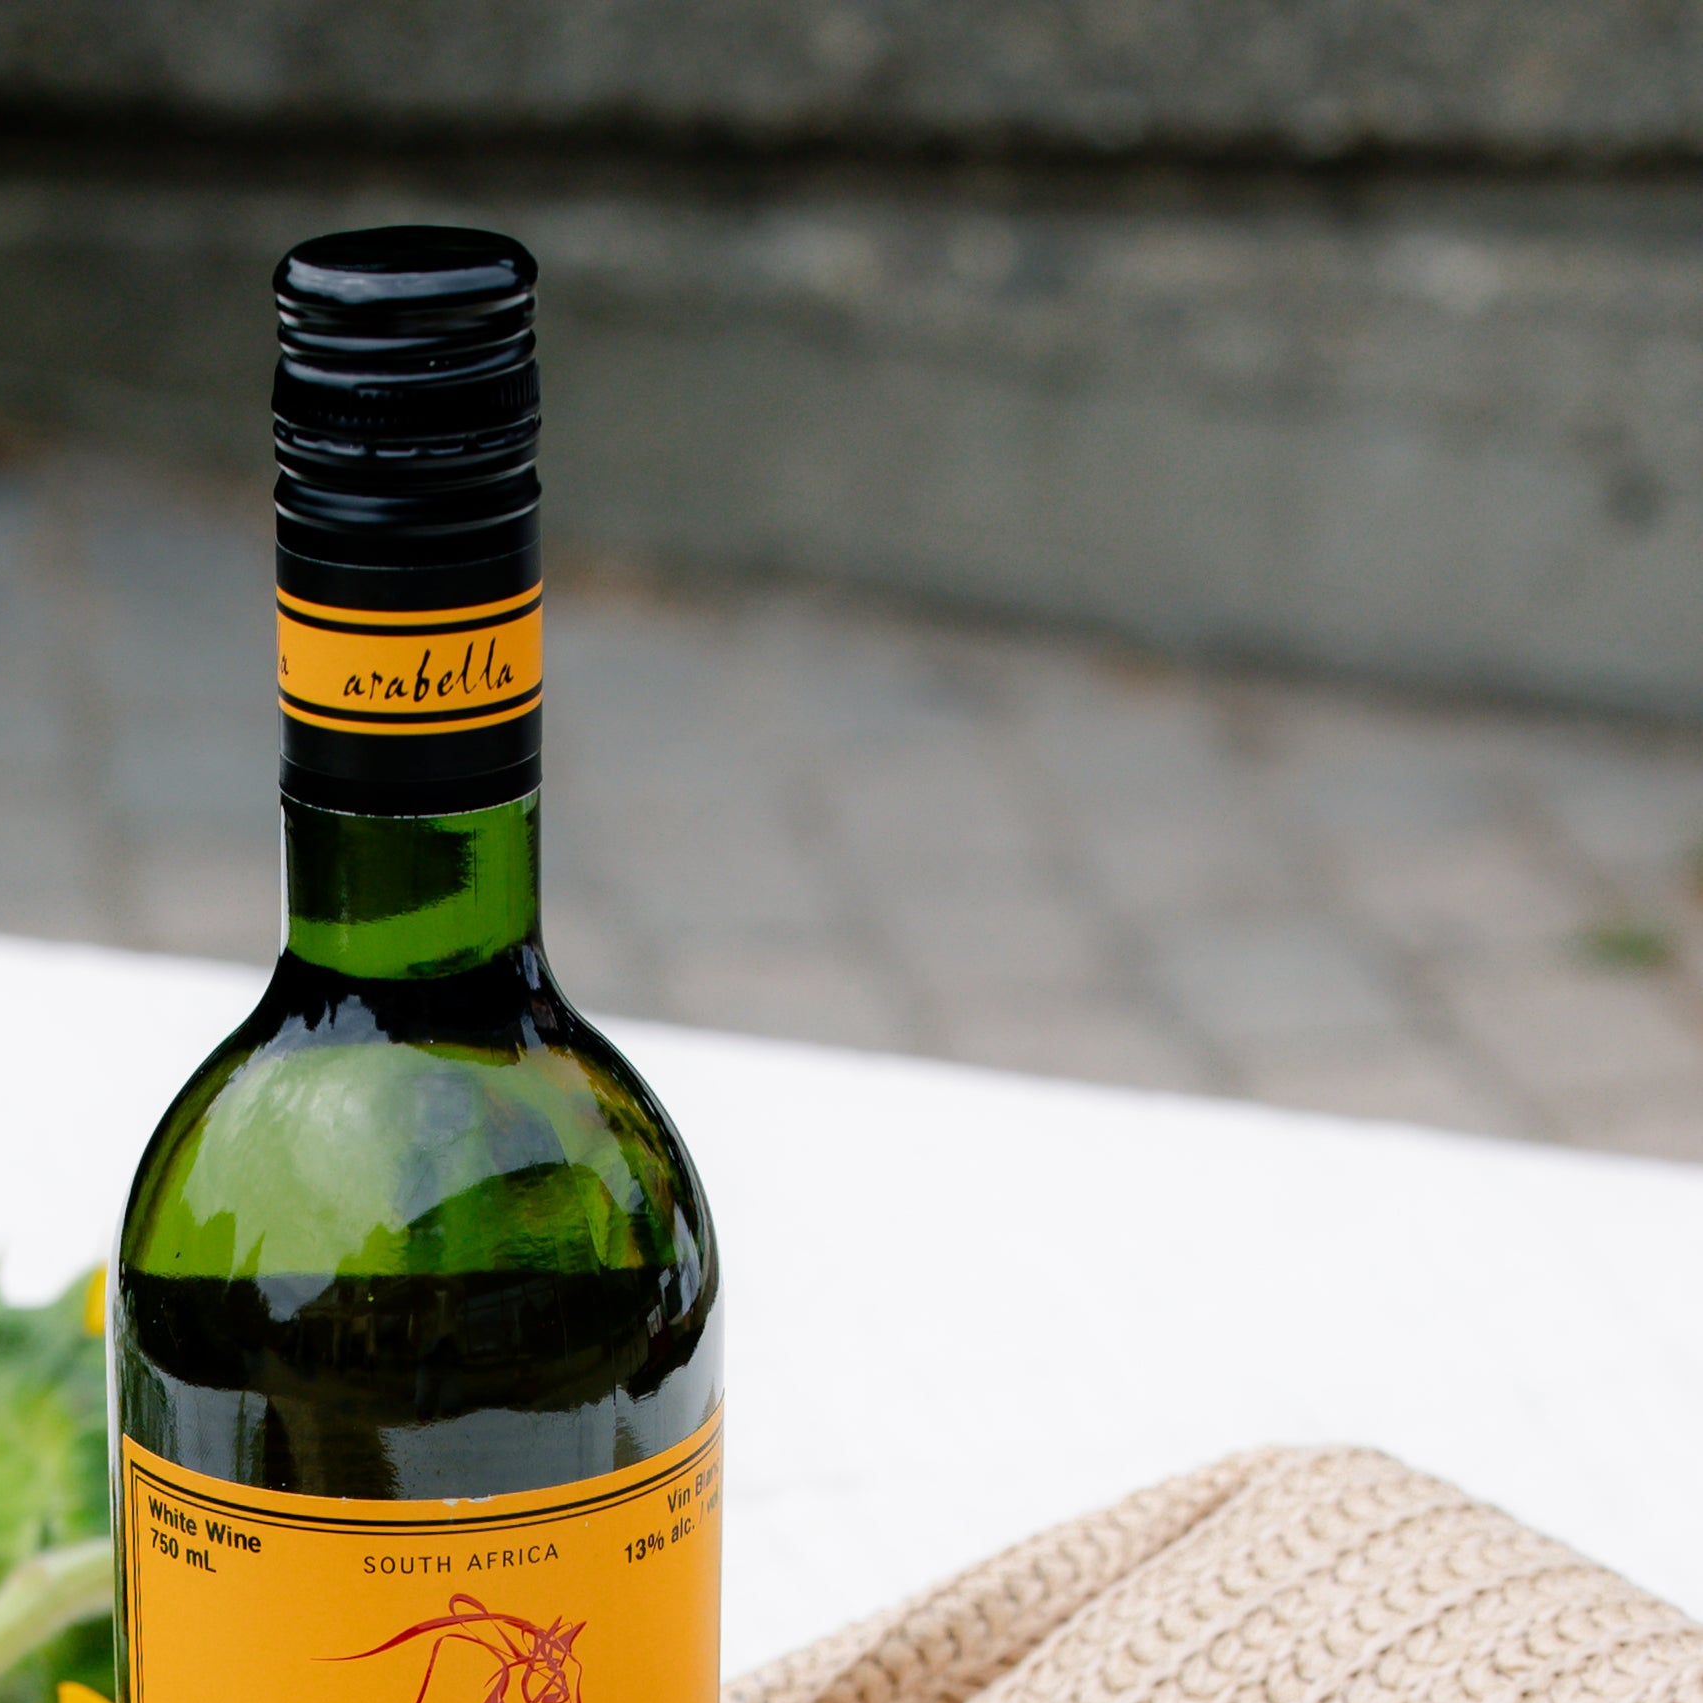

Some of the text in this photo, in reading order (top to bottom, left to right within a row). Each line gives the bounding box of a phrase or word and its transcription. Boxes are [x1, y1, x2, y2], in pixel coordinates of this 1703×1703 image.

[343, 637, 514, 702] arabella
[667, 1487, 691, 1514] Vin
[149, 1495, 262, 1554] White Wine
[624, 1530, 665, 1564] 13%
[671, 1517, 696, 1544] alc.
[150, 1527, 217, 1573] 750 mL
[363, 1543, 559, 1574] SOUTH AFRICA
